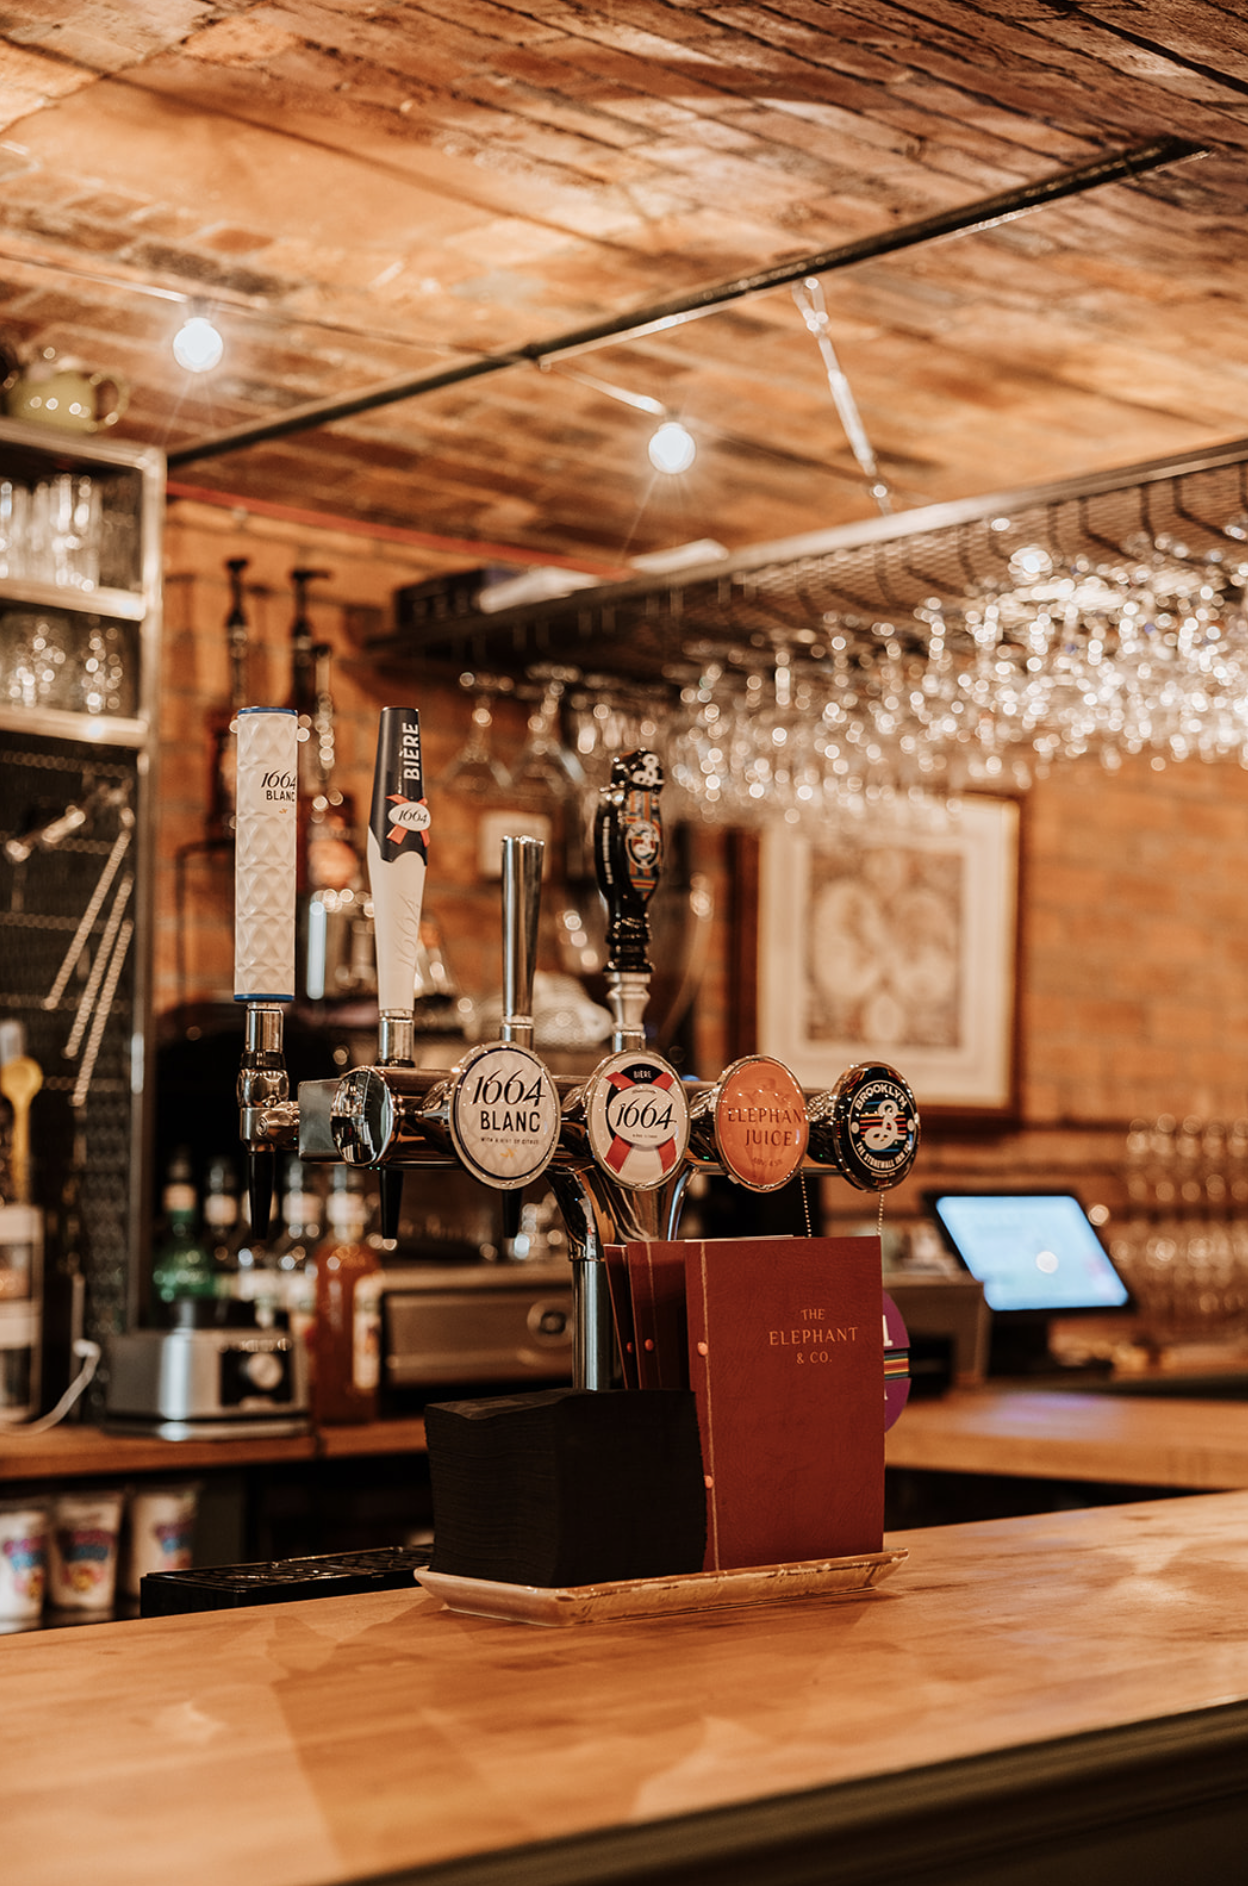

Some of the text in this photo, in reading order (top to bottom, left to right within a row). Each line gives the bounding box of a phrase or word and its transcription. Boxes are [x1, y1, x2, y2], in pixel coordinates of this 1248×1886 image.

[399, 722, 420, 781] BIÈRE
[261, 769, 297, 790] 1664
[398, 808, 428, 824] 1664
[472, 1069, 546, 1107] 1664
[854, 1083, 908, 1111] BROOKLYN
[480, 1110, 541, 1133] BLANC
[616, 1098, 677, 1130] 1664
[745, 1128, 793, 1147] JUICE
[800, 1308, 826, 1321] THE
[768, 1326, 859, 1346] ELEPHANT
[796, 1350, 833, 1365] & CO.
